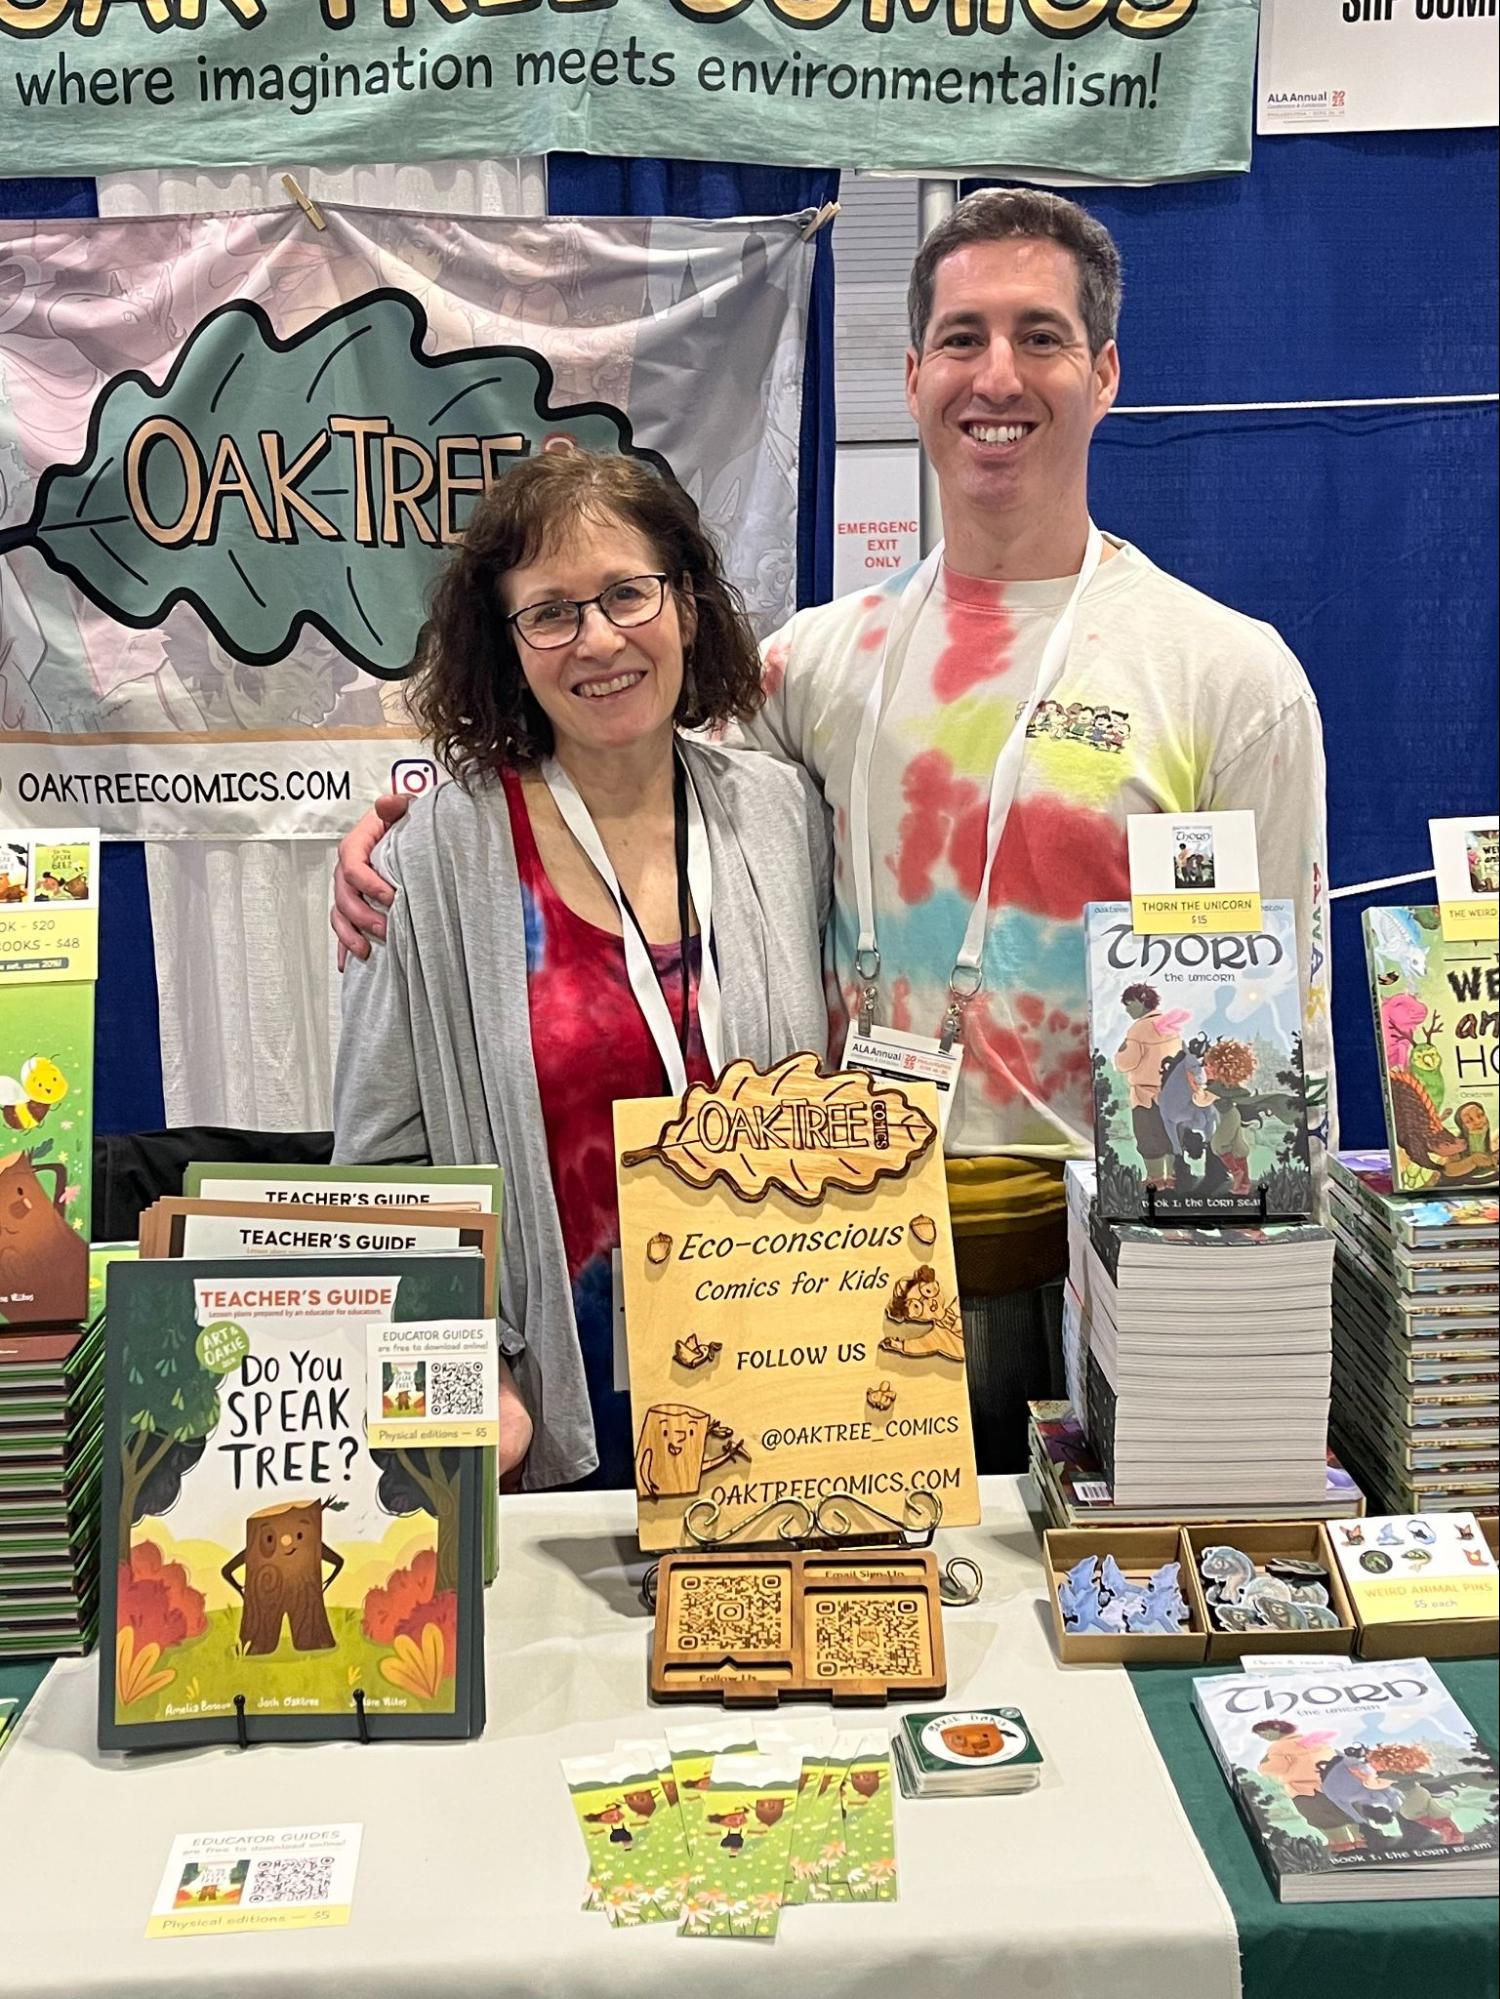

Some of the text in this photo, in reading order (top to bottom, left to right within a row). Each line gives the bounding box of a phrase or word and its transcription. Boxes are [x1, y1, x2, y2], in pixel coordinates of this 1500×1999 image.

[17, 36, 1162, 115] where imagination meets environmentalism!
[1267, 91, 1327, 103] ALA Annual
[838, 521, 918, 534] EMERGENC
[868, 539, 898, 551] EXIT
[865, 556, 901, 568] ONLY
[18, 770, 351, 804] OAKTREECOMICS.COM
[1143, 900, 1252, 912] THORN THE UNICORN
[1449, 908, 1497, 918] THE WEIRD
[32, 920, 55, 931] $20
[1191, 915, 1208, 925] $15
[0, 939, 40, 952] OOKS
[56, 938, 80, 949] $48
[852, 1043, 870, 1055] ALA
[871, 1047, 902, 1061] Annual
[698, 1098, 869, 1152] OAKTREE
[872, 1101, 890, 1150] COMICS
[265, 1191, 369, 1206] TEACHER'S
[240, 1229, 417, 1250] TEACHER'S GUIDE
[678, 1223, 905, 1261] Eco-conscious
[695, 1265, 890, 1302] Comics for Kids
[200, 1288, 392, 1308] TEACHER'S GUIDE
[203, 1327, 229, 1349] ART
[383, 1329, 484, 1342] EDUCATOR GUIDES
[204, 1336, 247, 1367] OAKIE
[393, 1344, 410, 1352] free
[424, 1343, 461, 1351] download
[737, 1344, 867, 1371] FOLLOW US
[226, 1386, 351, 1438] SPEAK
[379, 1429, 418, 1442] Physical
[420, 1430, 459, 1439] editions
[476, 1427, 488, 1438] $5
[761, 1415, 959, 1451] @OAKTREE_COMICS
[218, 1435, 360, 1490] TREE?
[711, 1467, 960, 1507] OAKTREECOMICS.COM
[1364, 1582, 1493, 1599] WEIRD ANIMAL PINS
[1432, 1600, 1458, 1608] each
[165, 1703, 199, 1717] Amelia
[192, 1830, 341, 1847] EDUCATOR GUIDES
[162, 1917, 222, 1930] Physical
[226, 1915, 286, 1925] editions
[311, 1911, 330, 1920] $5
